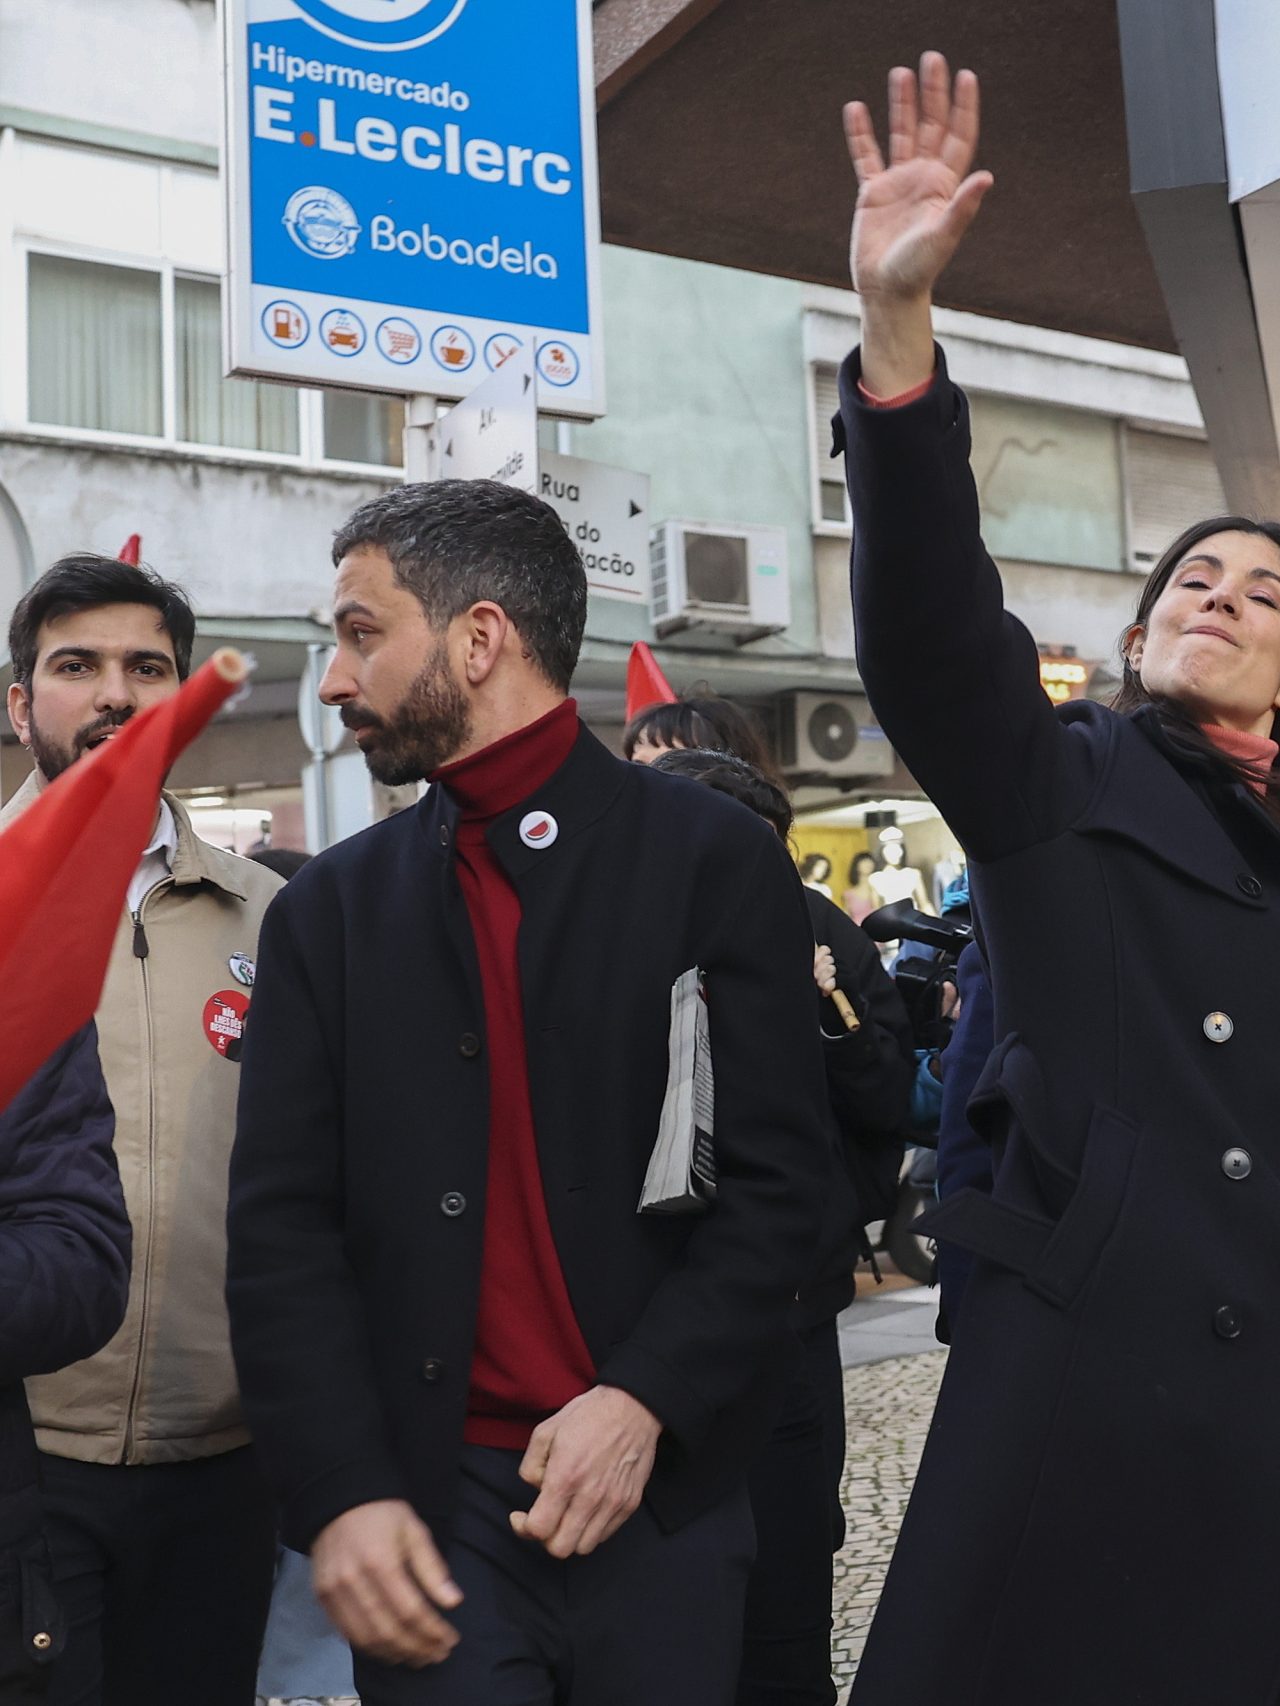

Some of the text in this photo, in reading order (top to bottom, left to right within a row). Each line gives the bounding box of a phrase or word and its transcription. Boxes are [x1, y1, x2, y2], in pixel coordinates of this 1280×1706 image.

[252, 42, 470, 112] Hipermercado
[253, 85, 572, 196] E.Leclerc
[370, 215, 558, 280] Bobadela
[541, 472, 580, 502] Rua
[576, 521, 600, 543] do
